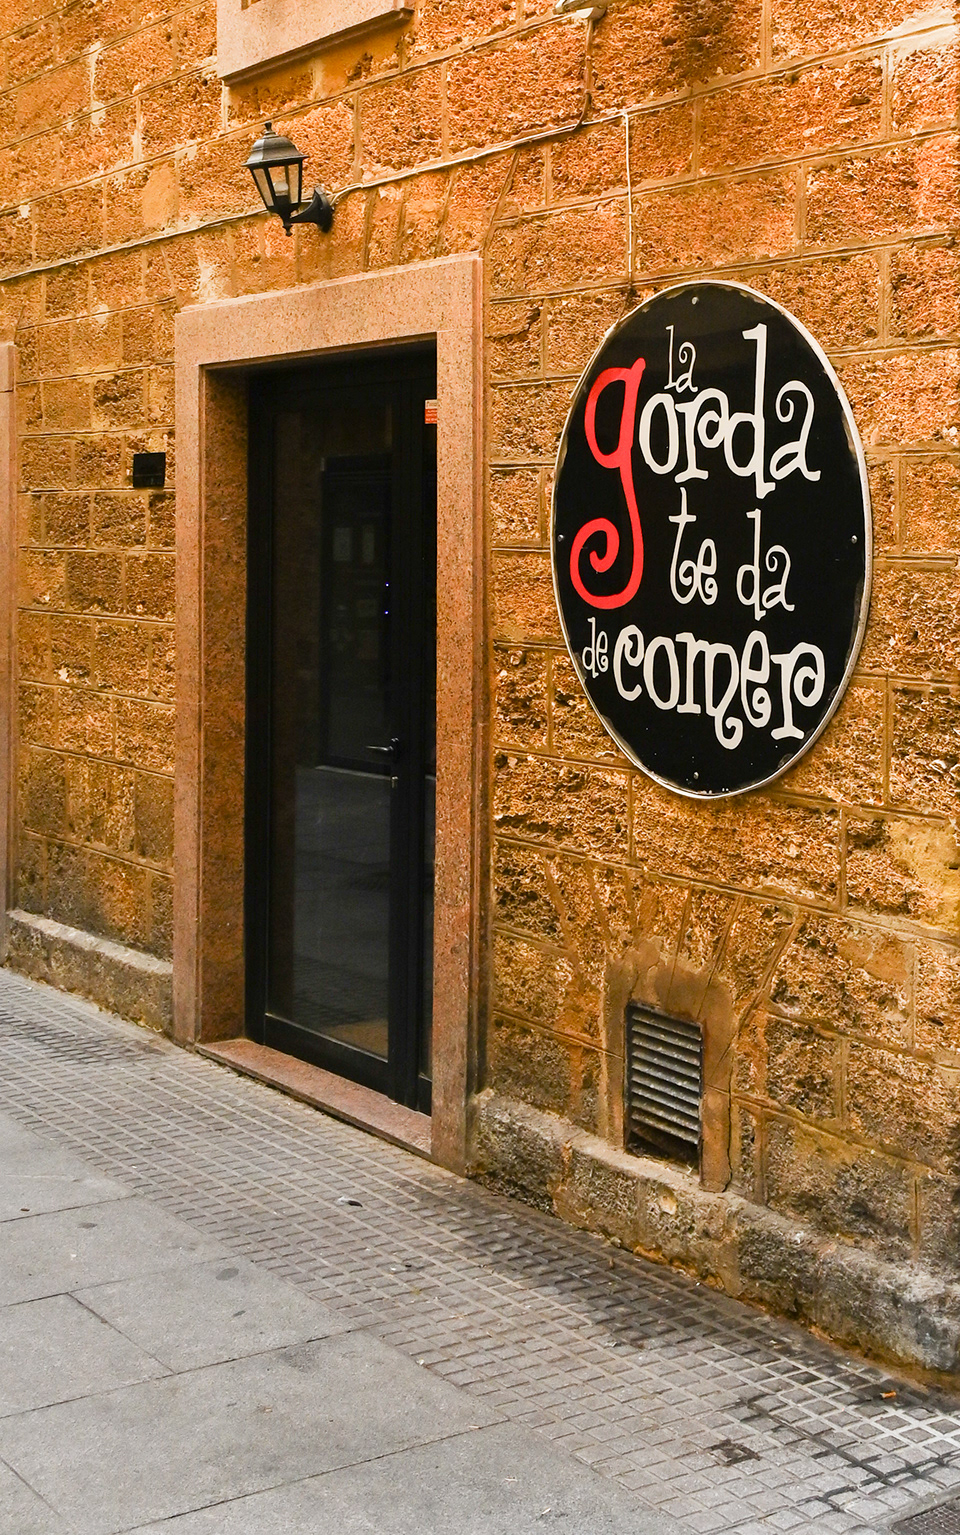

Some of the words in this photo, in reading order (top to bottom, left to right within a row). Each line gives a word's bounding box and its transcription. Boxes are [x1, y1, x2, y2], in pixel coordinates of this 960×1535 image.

[664, 325, 698, 393] la
[569, 323, 821, 610] gorda
[669, 486, 717, 606] te
[736, 509, 796, 621] da
[581, 617, 608, 680] de
[614, 624, 826, 749] comer
